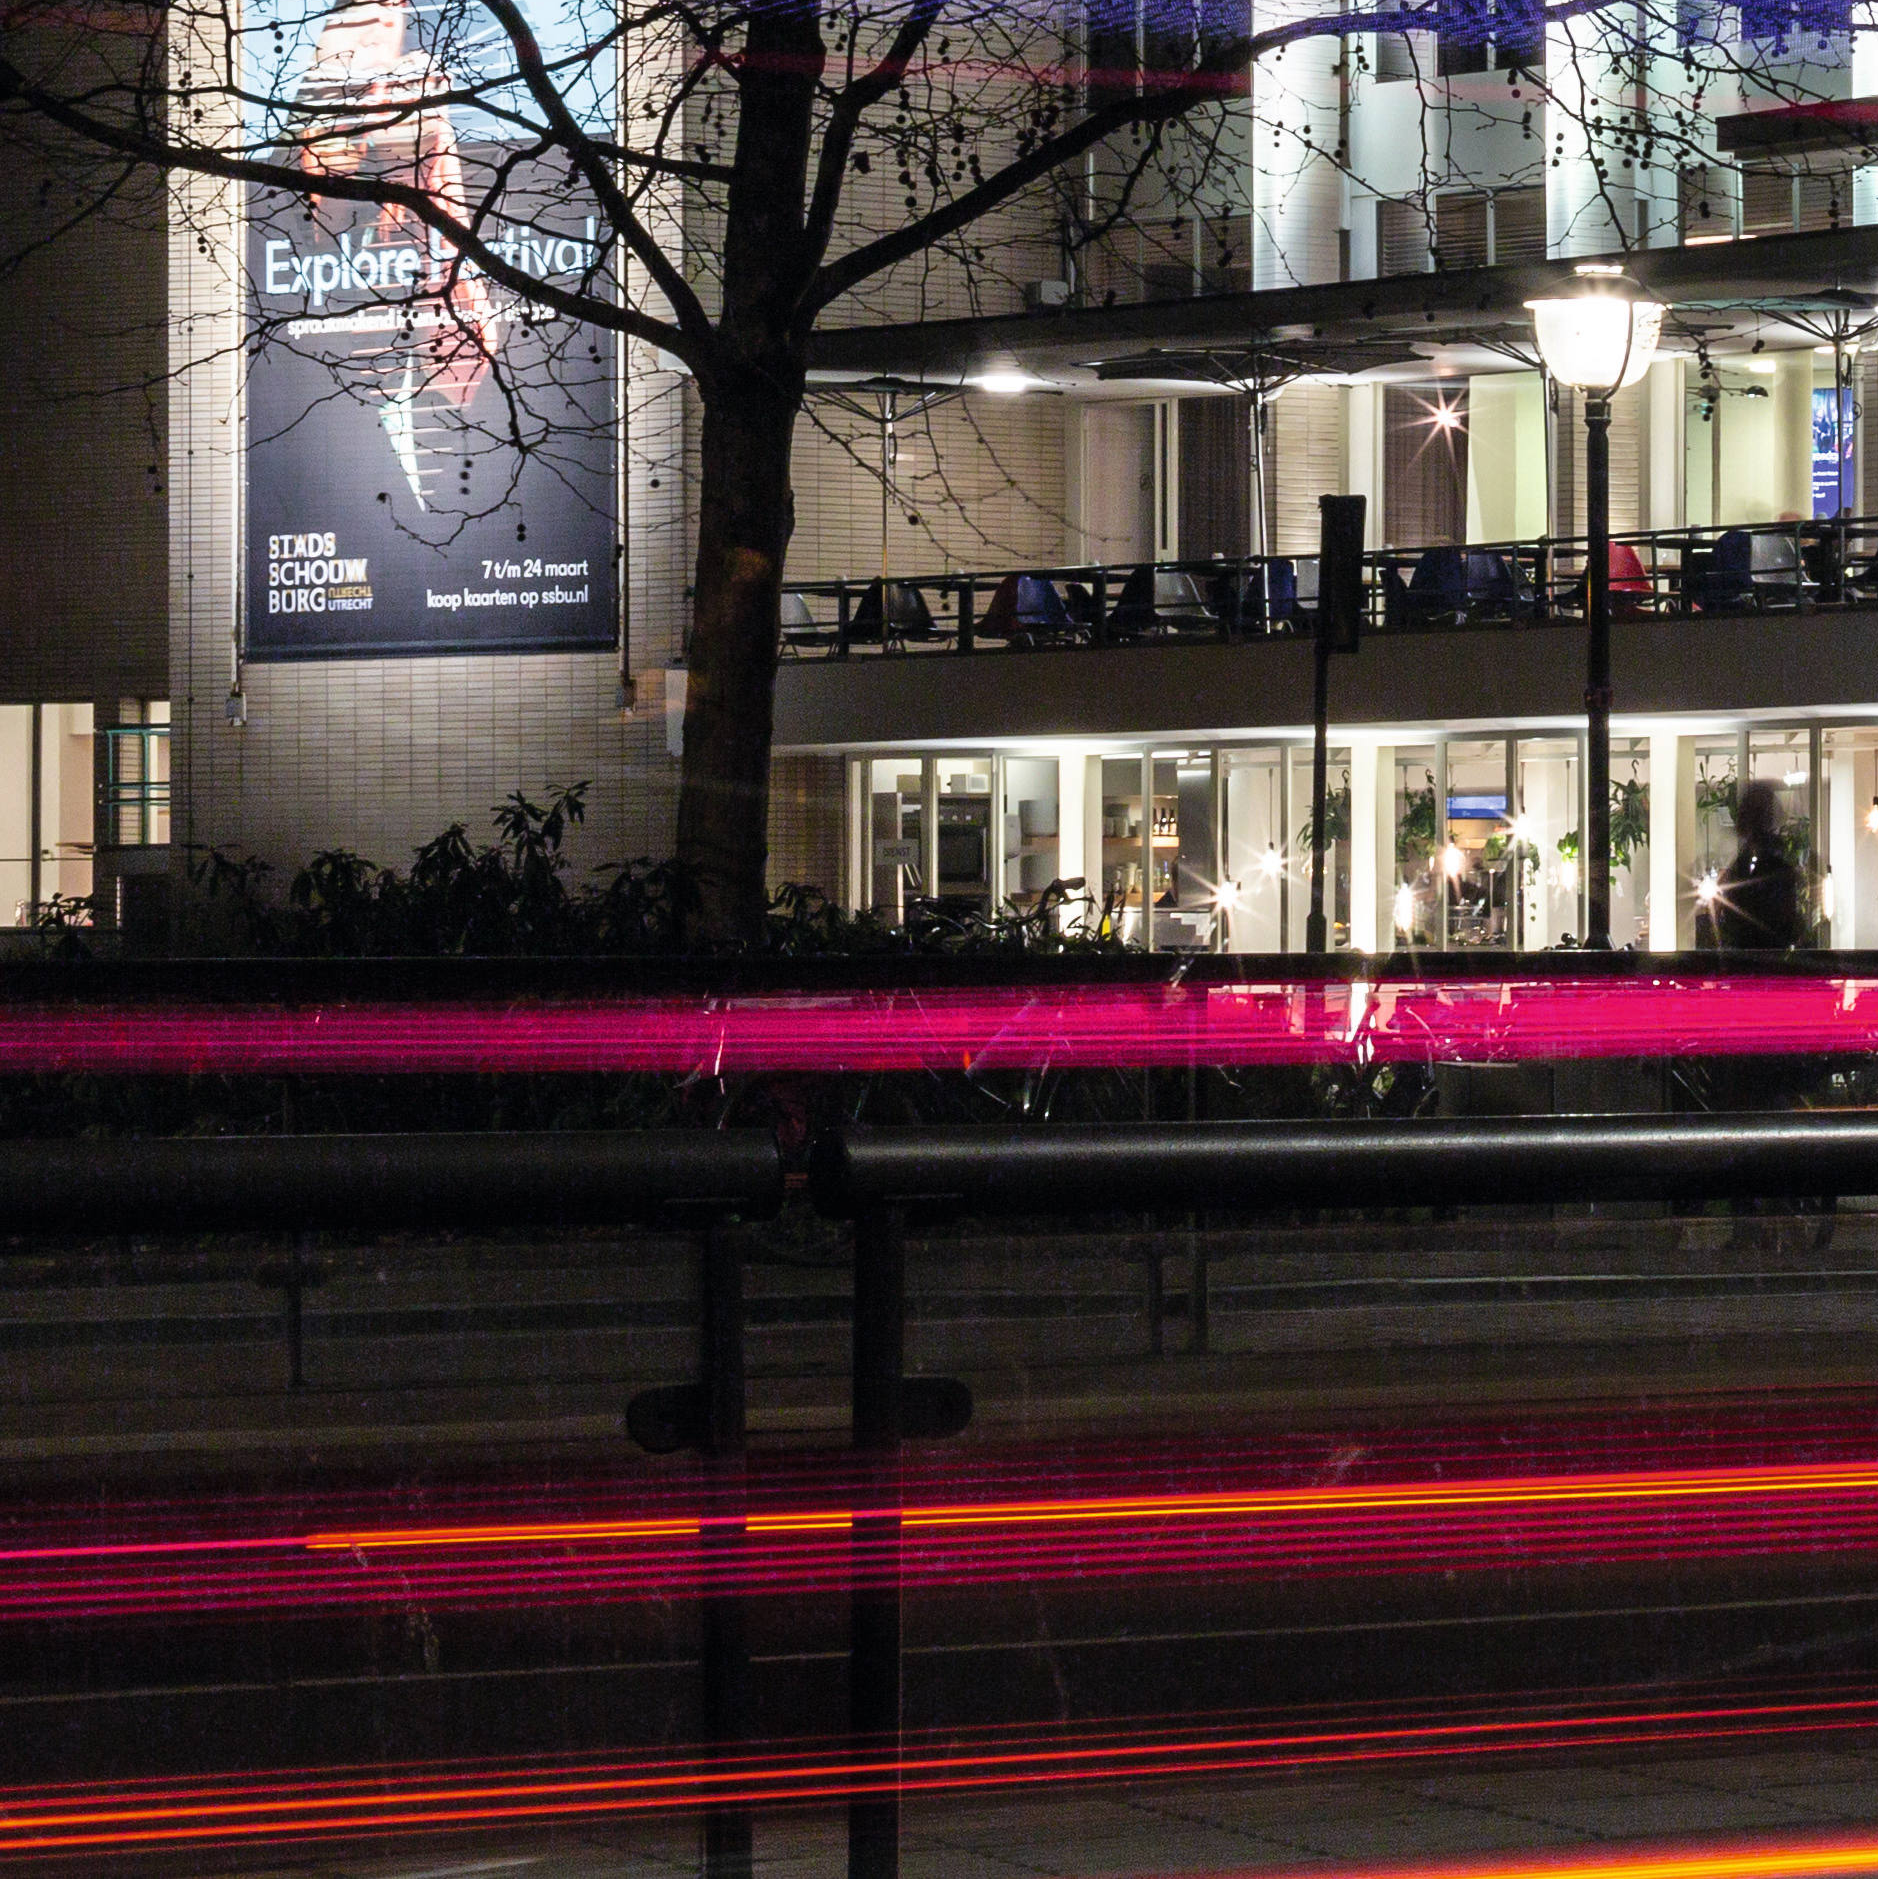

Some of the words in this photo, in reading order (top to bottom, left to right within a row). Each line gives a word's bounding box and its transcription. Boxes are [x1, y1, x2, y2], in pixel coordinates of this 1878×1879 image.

[264, 231, 422, 306] Explore
[268, 531, 337, 560] STADS
[268, 558, 369, 587] SCHOUW
[481, 559, 493, 579] 7
[493, 558, 521, 579] t/m
[523, 557, 542, 578] 24
[545, 559, 589, 577] maart
[268, 586, 327, 614] BURG
[327, 597, 374, 612] UTRECHT
[426, 588, 462, 612] koop
[463, 586, 517, 607] kaarten
[519, 590, 539, 609] op
[541, 583, 589, 605] ssbu.nl
